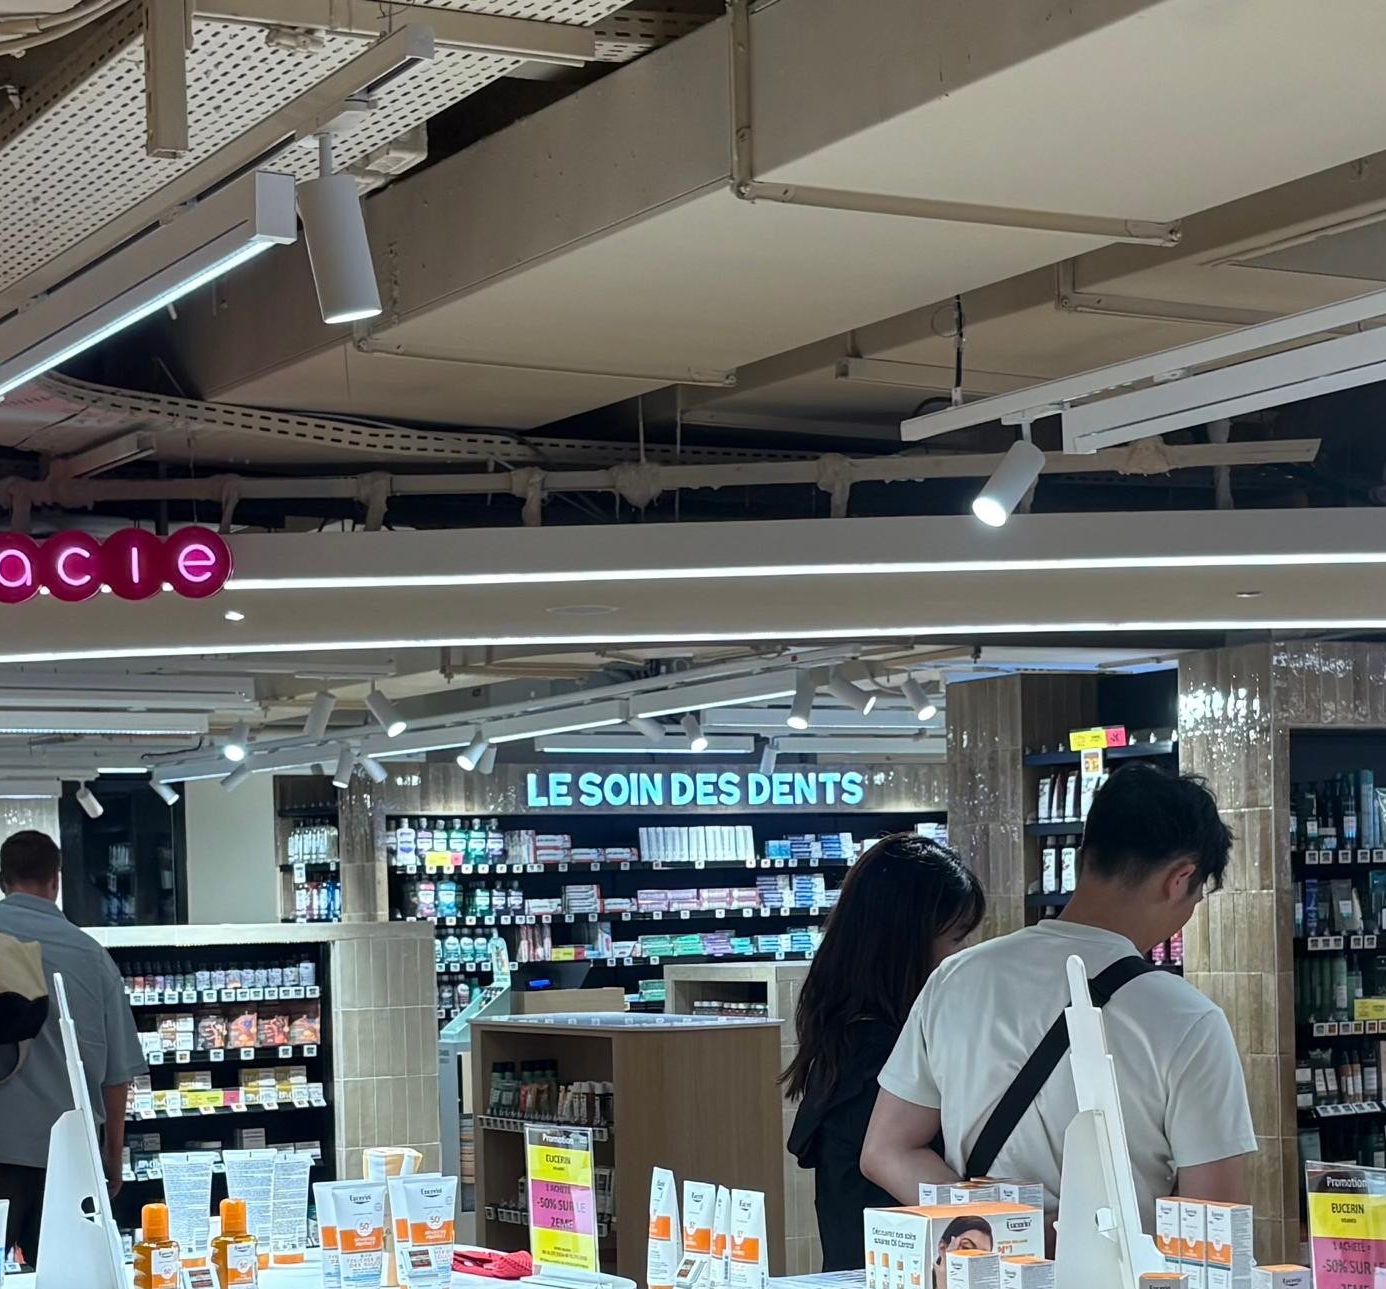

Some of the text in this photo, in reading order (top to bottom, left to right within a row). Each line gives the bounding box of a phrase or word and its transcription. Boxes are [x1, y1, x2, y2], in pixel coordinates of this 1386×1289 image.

[527, 772, 864, 807] LE SOIN DES DENTS
[545, 1153, 571, 1165] EUCERIN
[1326, 1176, 1367, 1189] Promotion
[537, 1197, 557, 1210] -50%
[559, 1199, 574, 1212] SUR
[1331, 1202, 1365, 1215] EUCERIN
[1322, 1259, 1347, 1273] -50%
[1350, 1261, 1372, 1275] SUR
